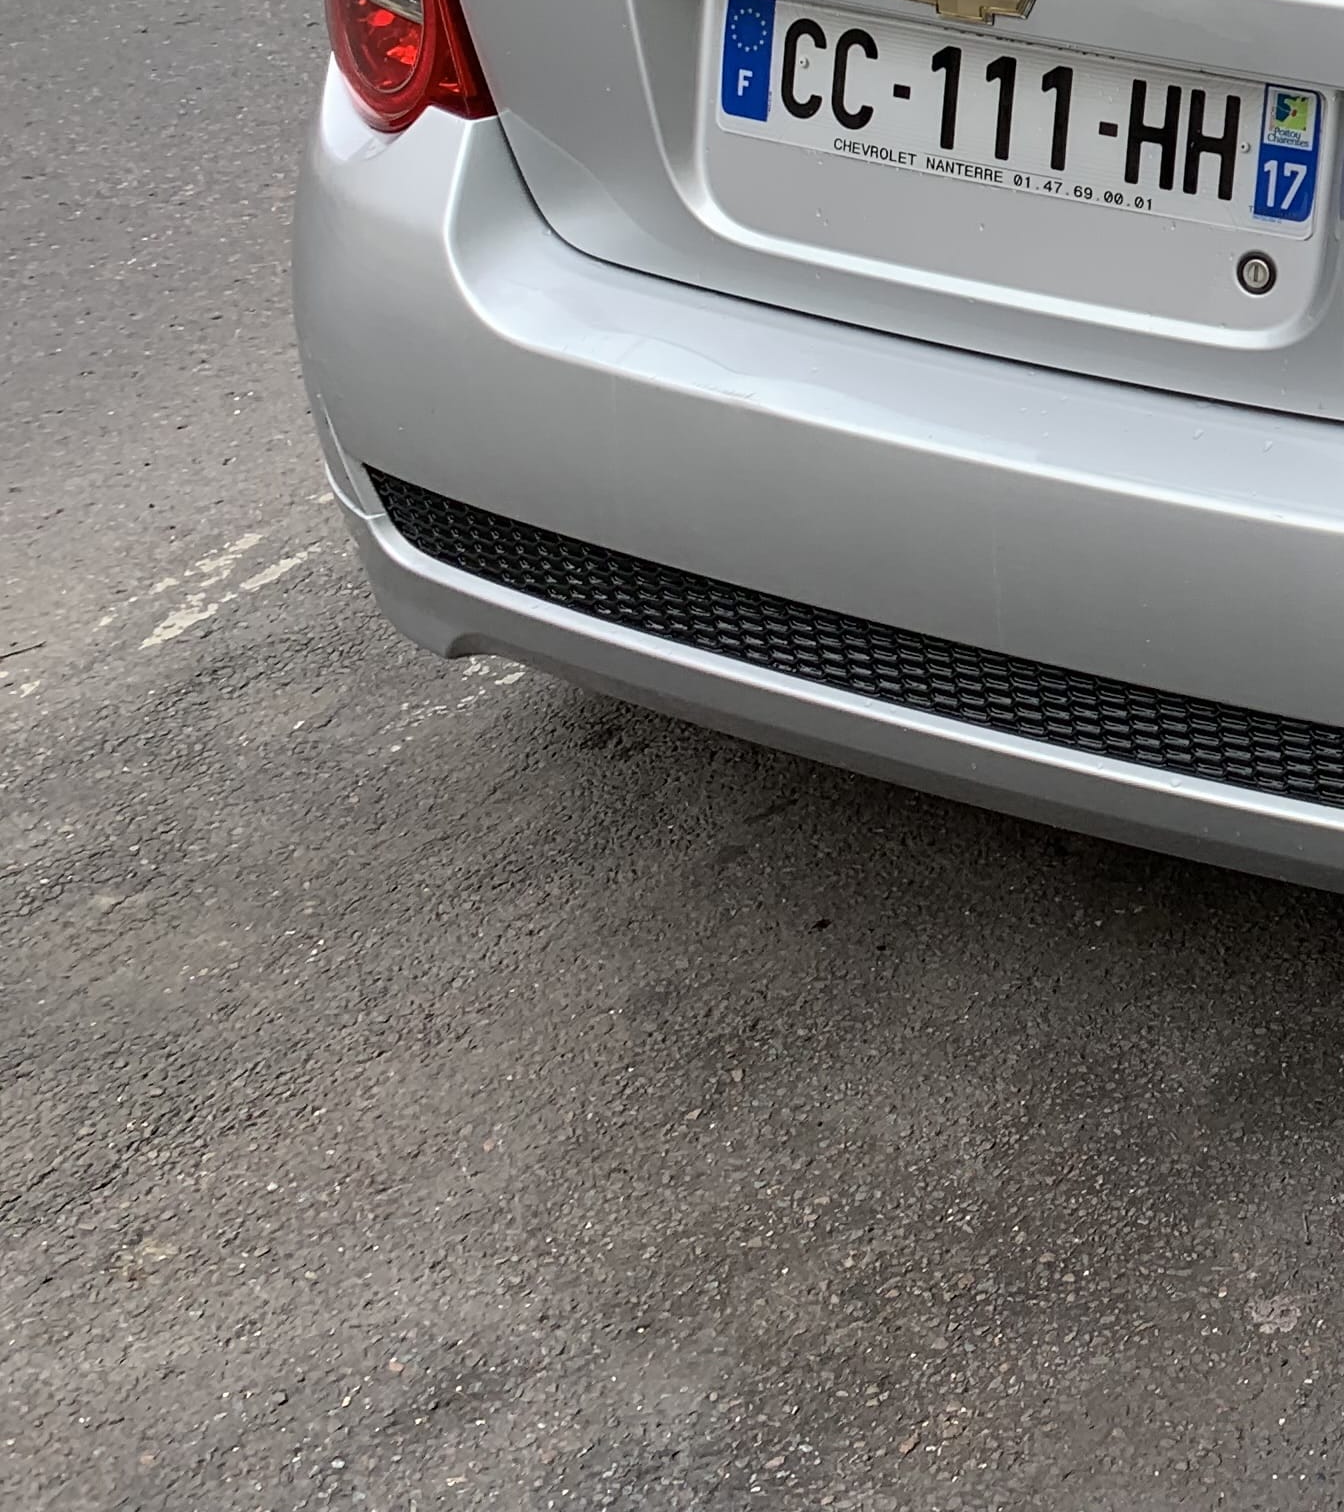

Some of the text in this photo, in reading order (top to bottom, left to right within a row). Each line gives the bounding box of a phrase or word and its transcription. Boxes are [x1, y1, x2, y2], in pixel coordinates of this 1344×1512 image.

[737, 69, 753, 96] F
[781, 18, 1241, 201] CC-111-HH
[833, 138, 1153, 211] CHEVROLET NANTERRE 01.47.69.00.01
[1264, 159, 1307, 210] 17
